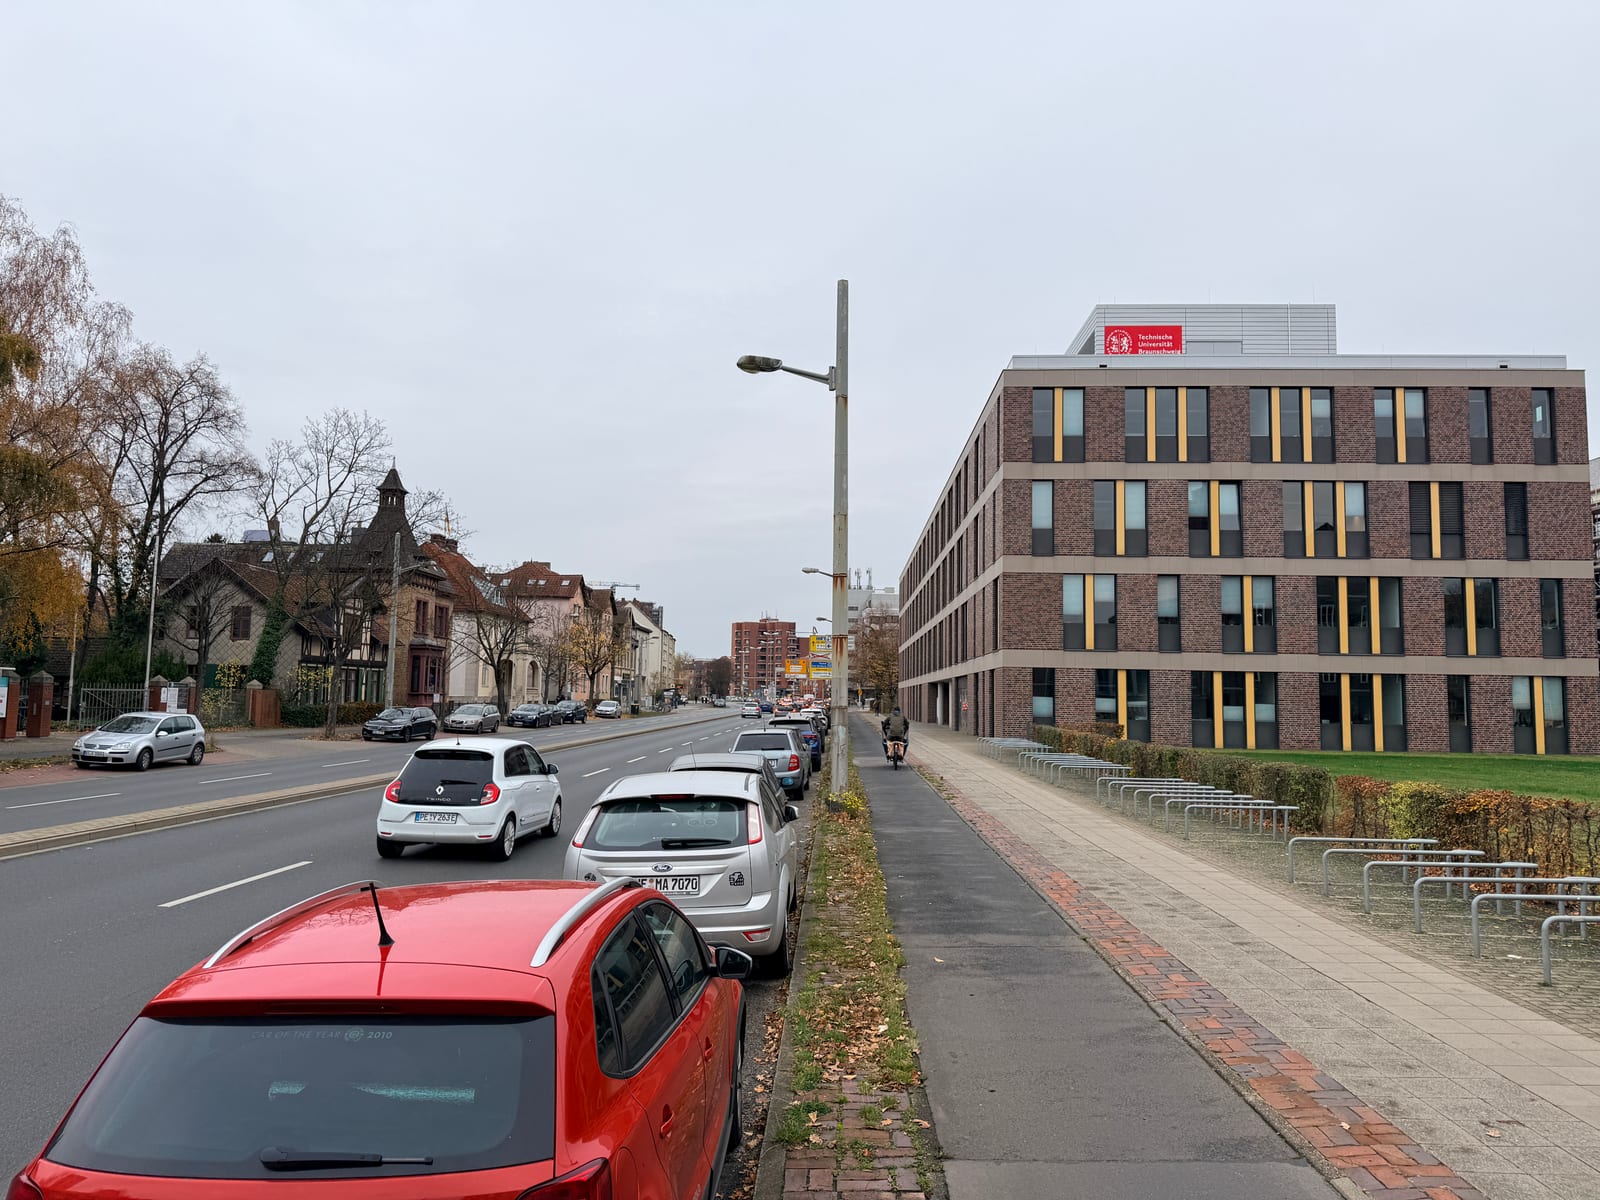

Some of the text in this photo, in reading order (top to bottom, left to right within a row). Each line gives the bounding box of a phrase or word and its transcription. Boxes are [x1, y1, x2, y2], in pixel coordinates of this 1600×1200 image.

[420, 813, 428, 821] PE
[655, 878, 669, 890] MA
[671, 878, 698, 890] 7070
[368, 1031, 393, 1039] 2010
